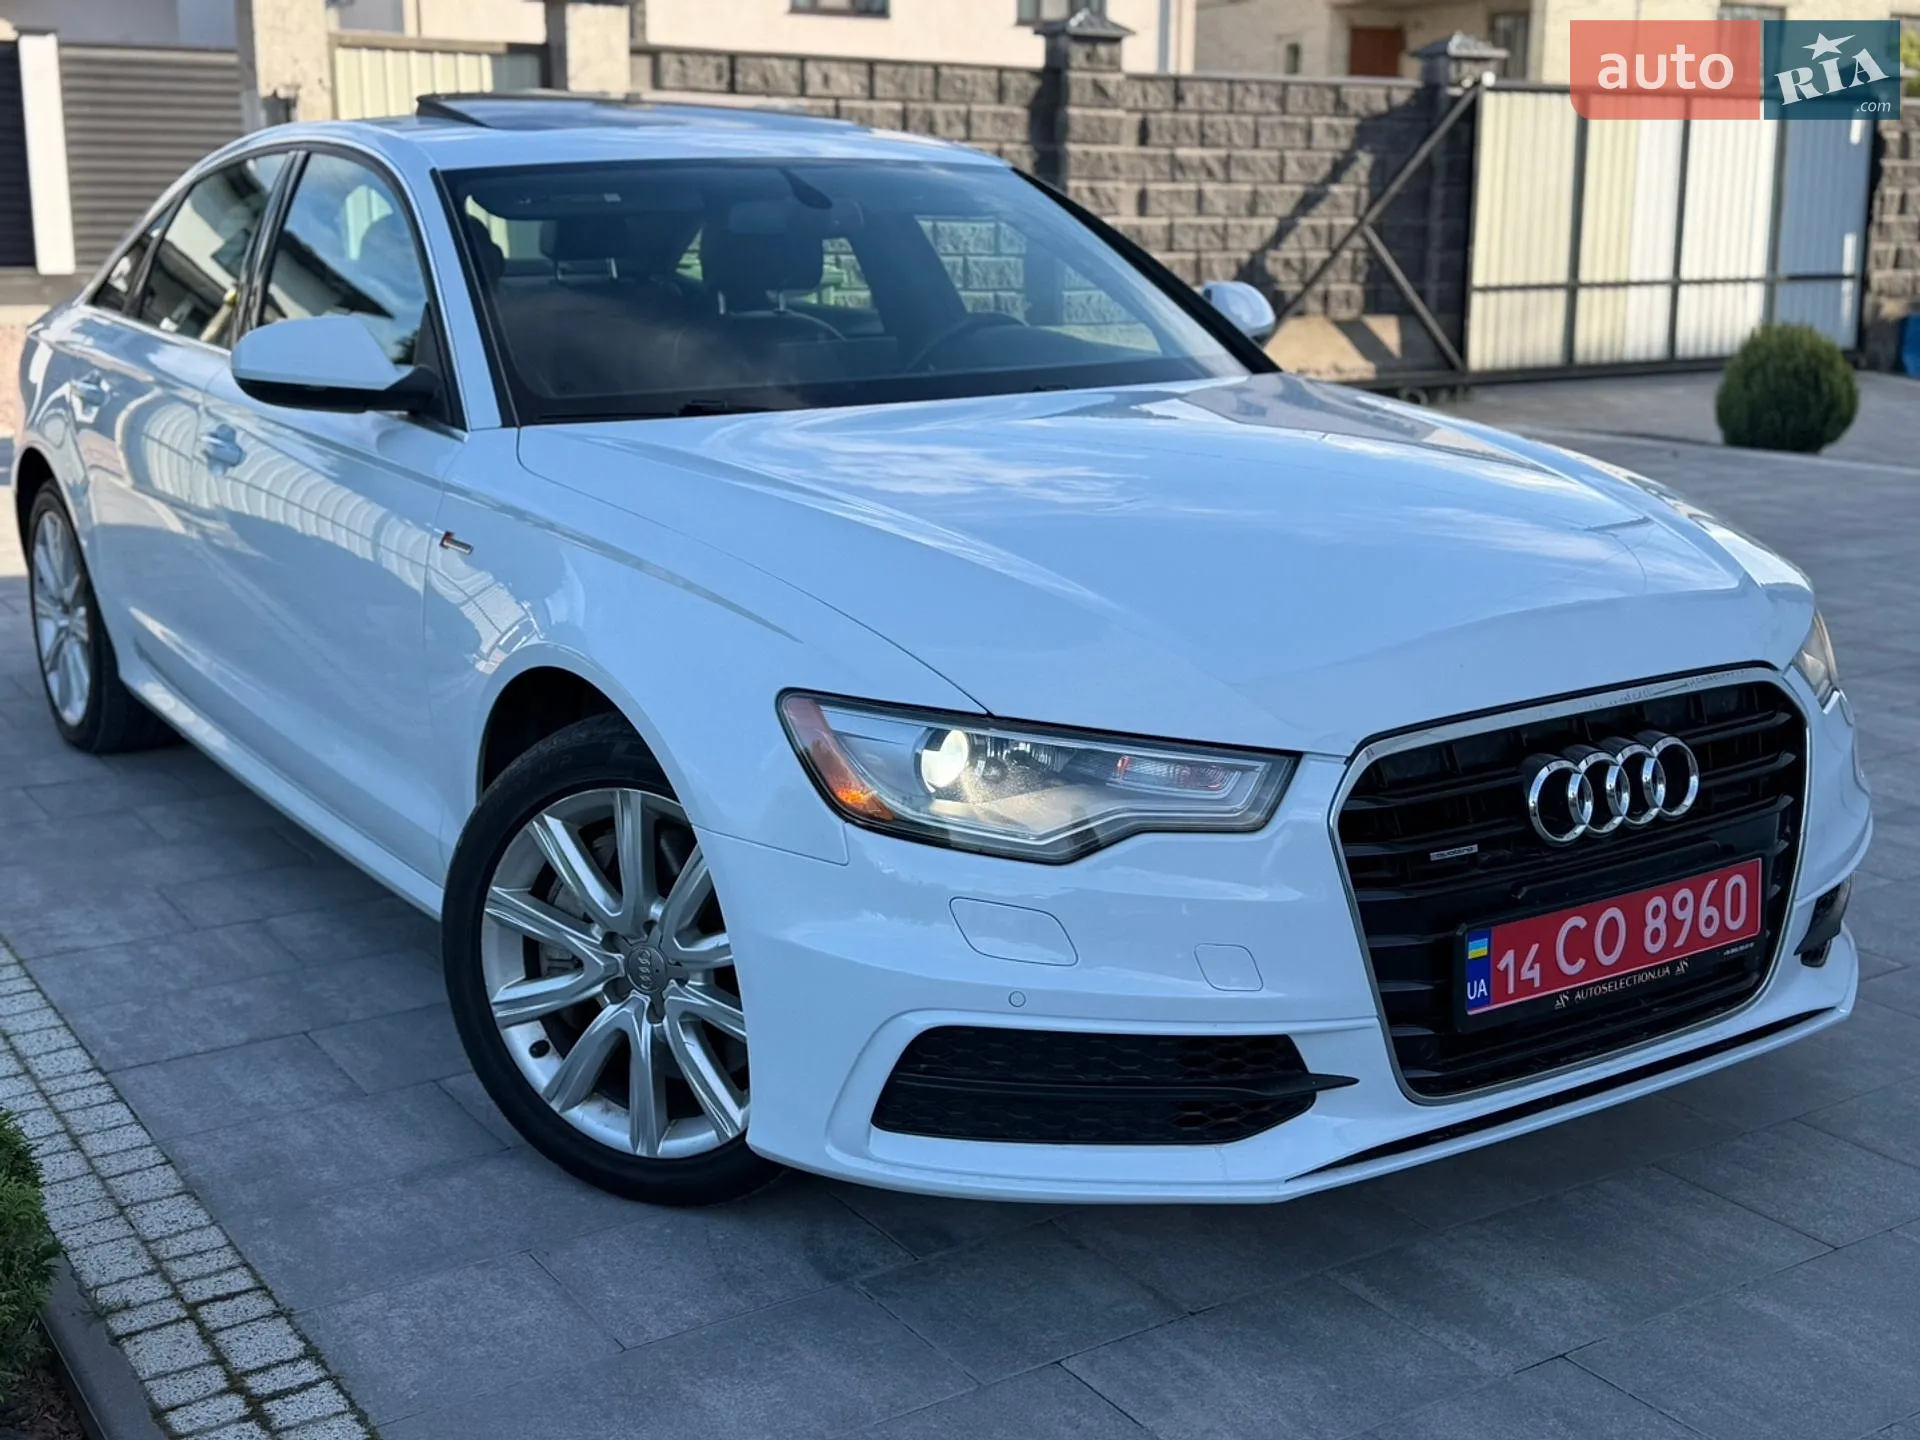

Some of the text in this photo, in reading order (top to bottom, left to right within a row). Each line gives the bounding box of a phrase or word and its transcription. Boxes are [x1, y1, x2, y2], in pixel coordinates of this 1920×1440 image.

[1497, 873, 1748, 996] 14 CO 8960
[1467, 977, 1489, 1001] UA
[1574, 964, 1671, 1002] AUTOSELECTION.UA
